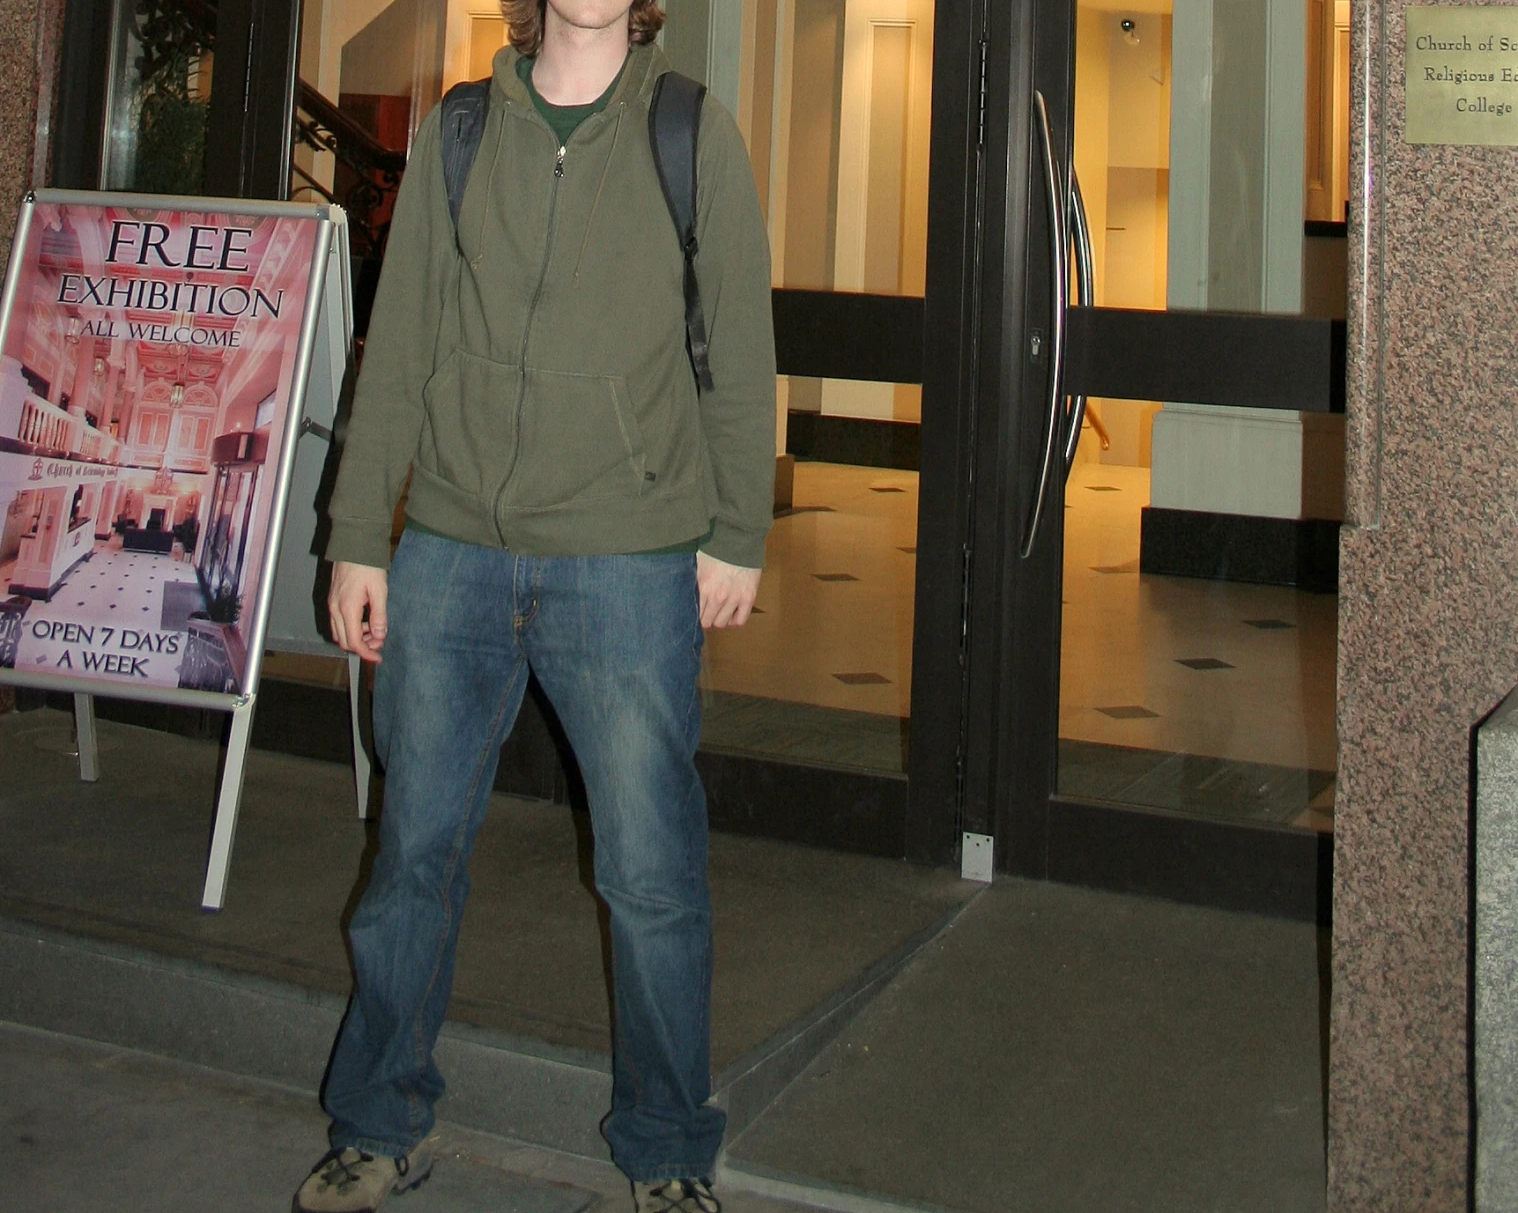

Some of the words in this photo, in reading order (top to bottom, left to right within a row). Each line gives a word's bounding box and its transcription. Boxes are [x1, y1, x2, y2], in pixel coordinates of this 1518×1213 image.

[1415, 34, 1472, 51] Church
[1478, 35, 1494, 51] of
[1423, 65, 1495, 86] Religious
[1456, 96, 1513, 117] College
[105, 219, 252, 272] FREE
[57, 273, 284, 319] EXHIBITION
[80, 319, 120, 338] ALL
[129, 323, 242, 348] WELCOME
[32, 619, 96, 646] OPEN
[101, 626, 115, 647] 7
[119, 629, 179, 655] DAYS
[56, 649, 73, 669] A
[82, 650, 150, 678] WEEK
